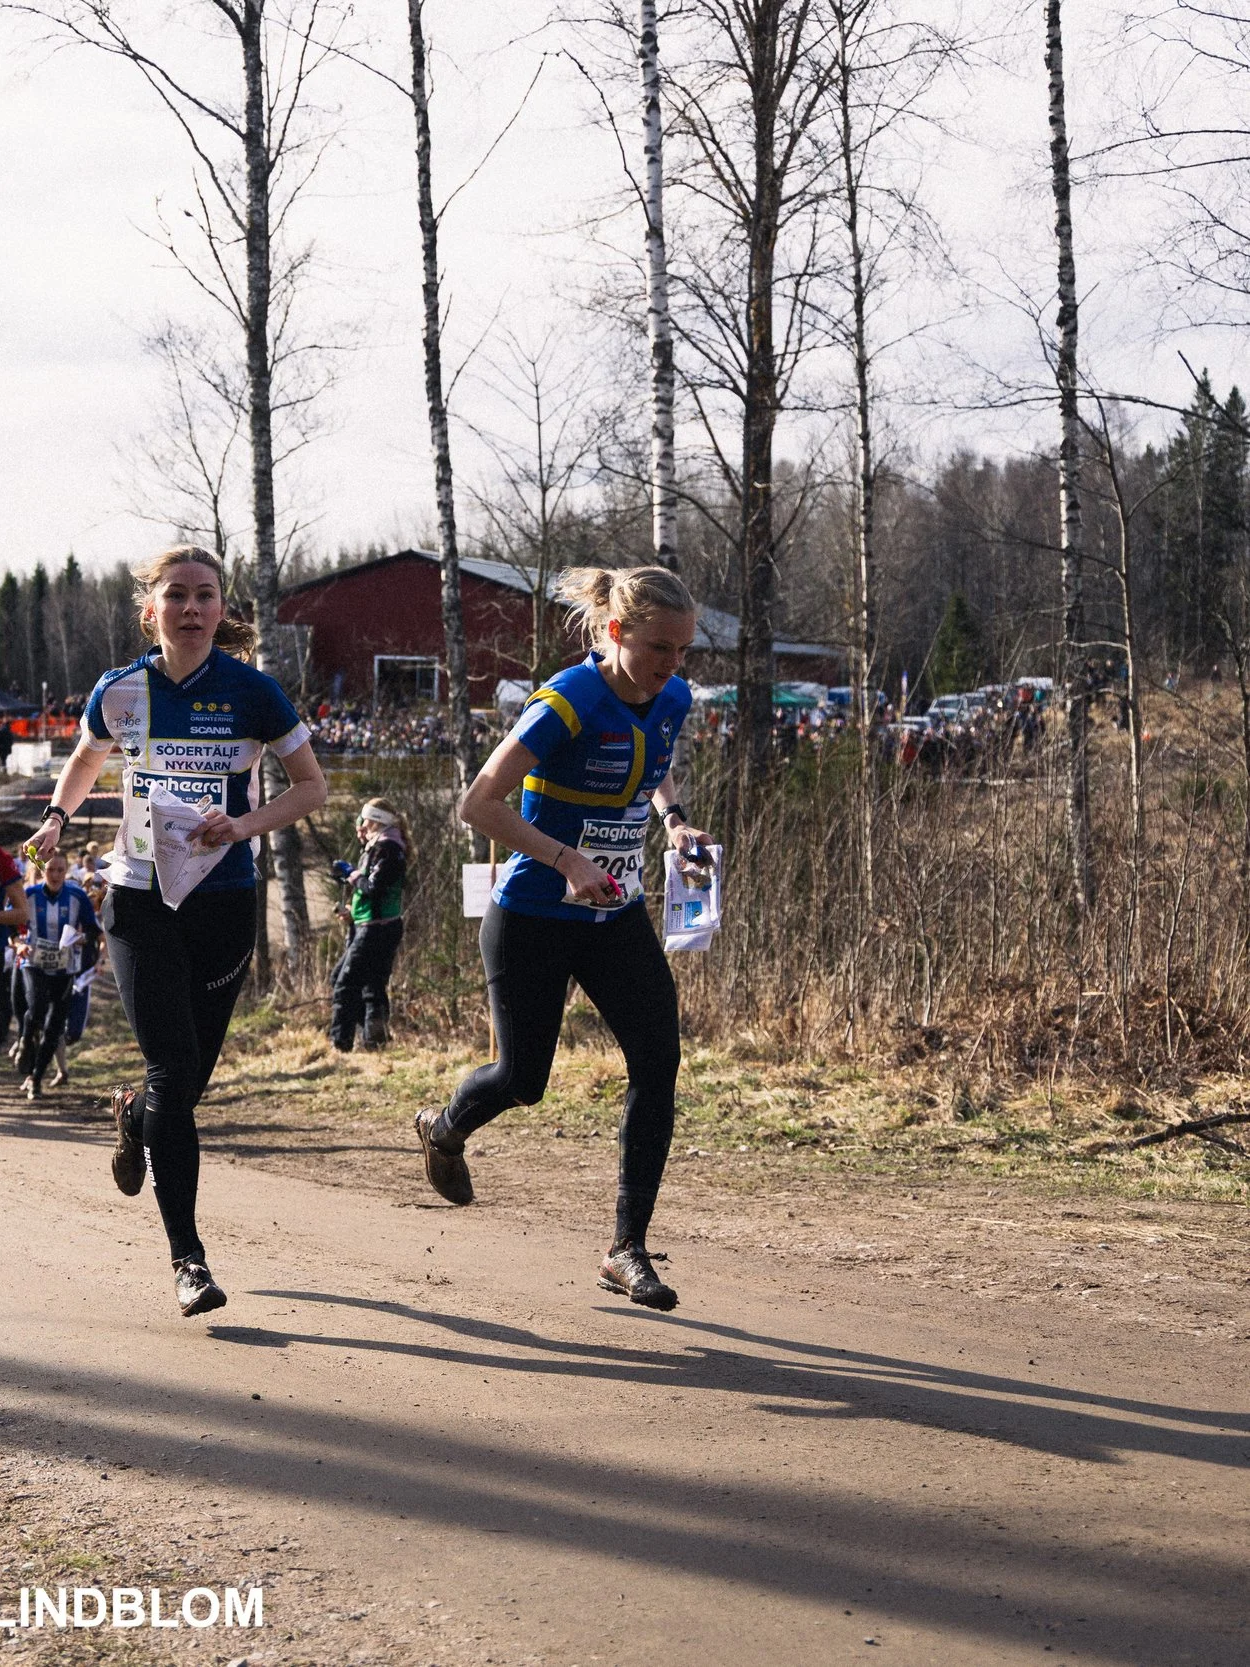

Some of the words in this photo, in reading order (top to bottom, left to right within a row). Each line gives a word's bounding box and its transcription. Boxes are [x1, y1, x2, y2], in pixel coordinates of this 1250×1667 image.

[181, 663, 210, 690] noname
[115, 717, 141, 728] Telge
[190, 726, 232, 735] SCANIA
[156, 743, 240, 758] SÖDERTÄLJE
[165, 760, 231, 772] NYKVARN
[584, 780, 622, 789] TRIMTEX
